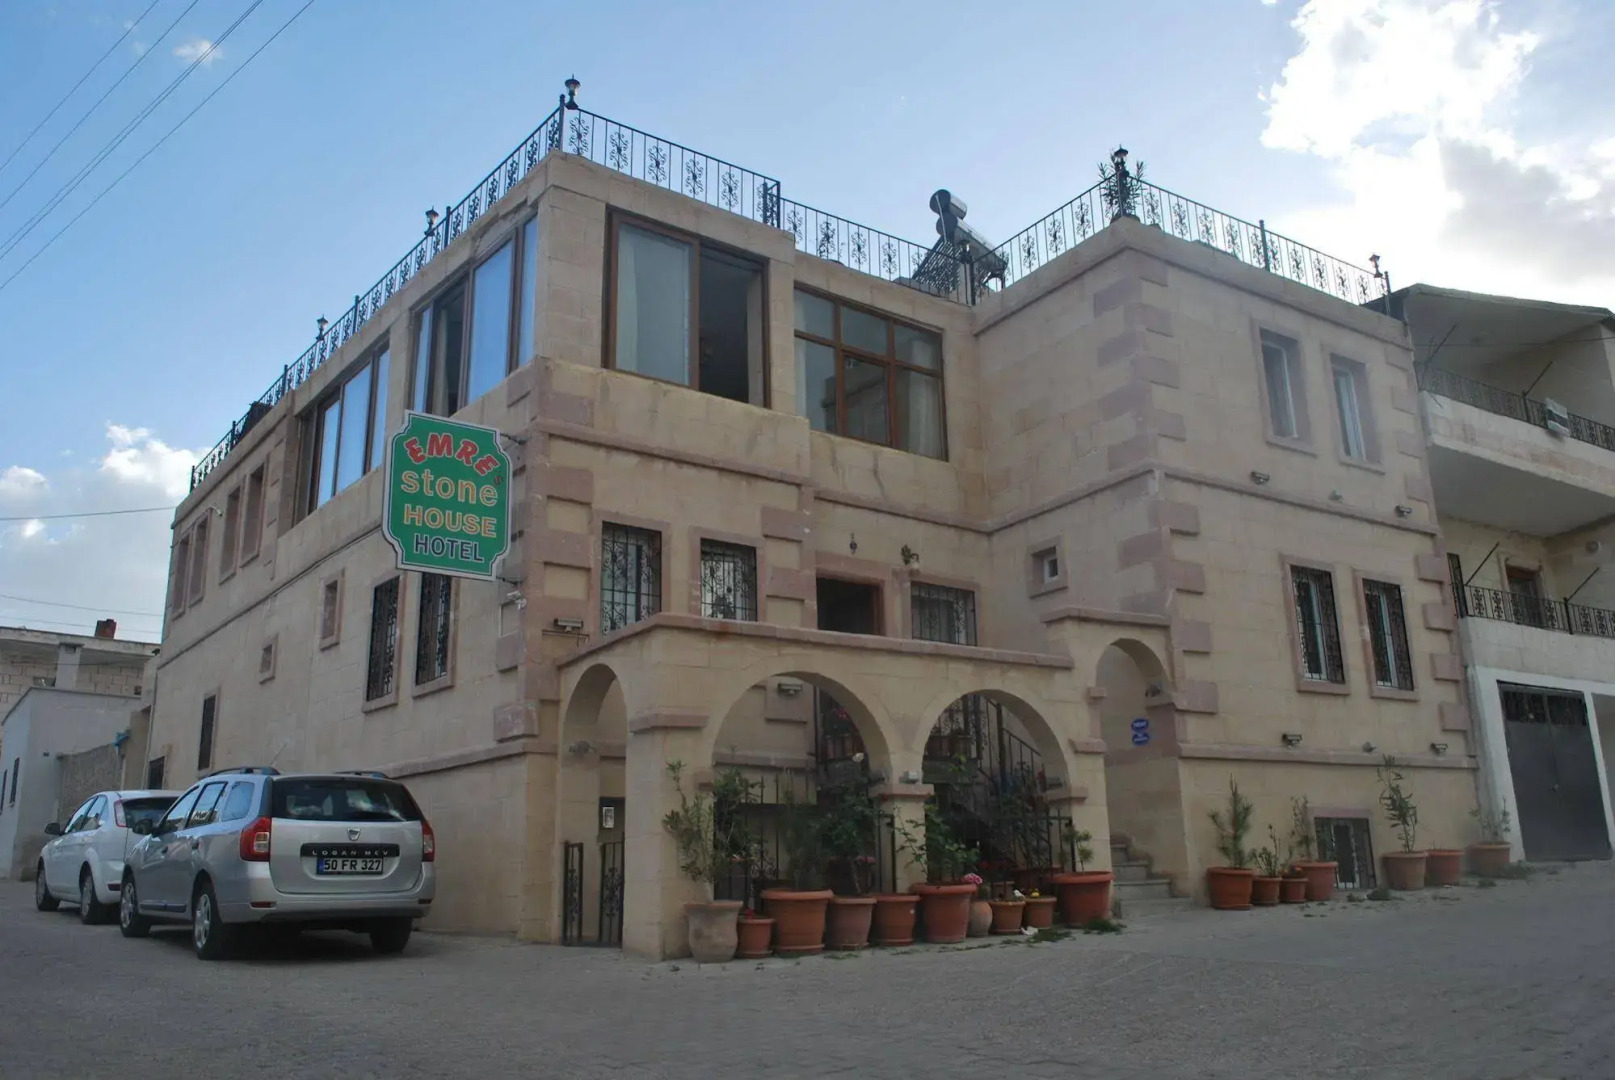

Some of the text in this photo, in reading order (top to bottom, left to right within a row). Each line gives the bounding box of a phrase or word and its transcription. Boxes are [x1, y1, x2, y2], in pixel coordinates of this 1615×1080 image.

[403, 503, 497, 538] HOUSE
[413, 532, 484, 562] HOTEL
[324, 859, 381, 871] 50 FR 327
